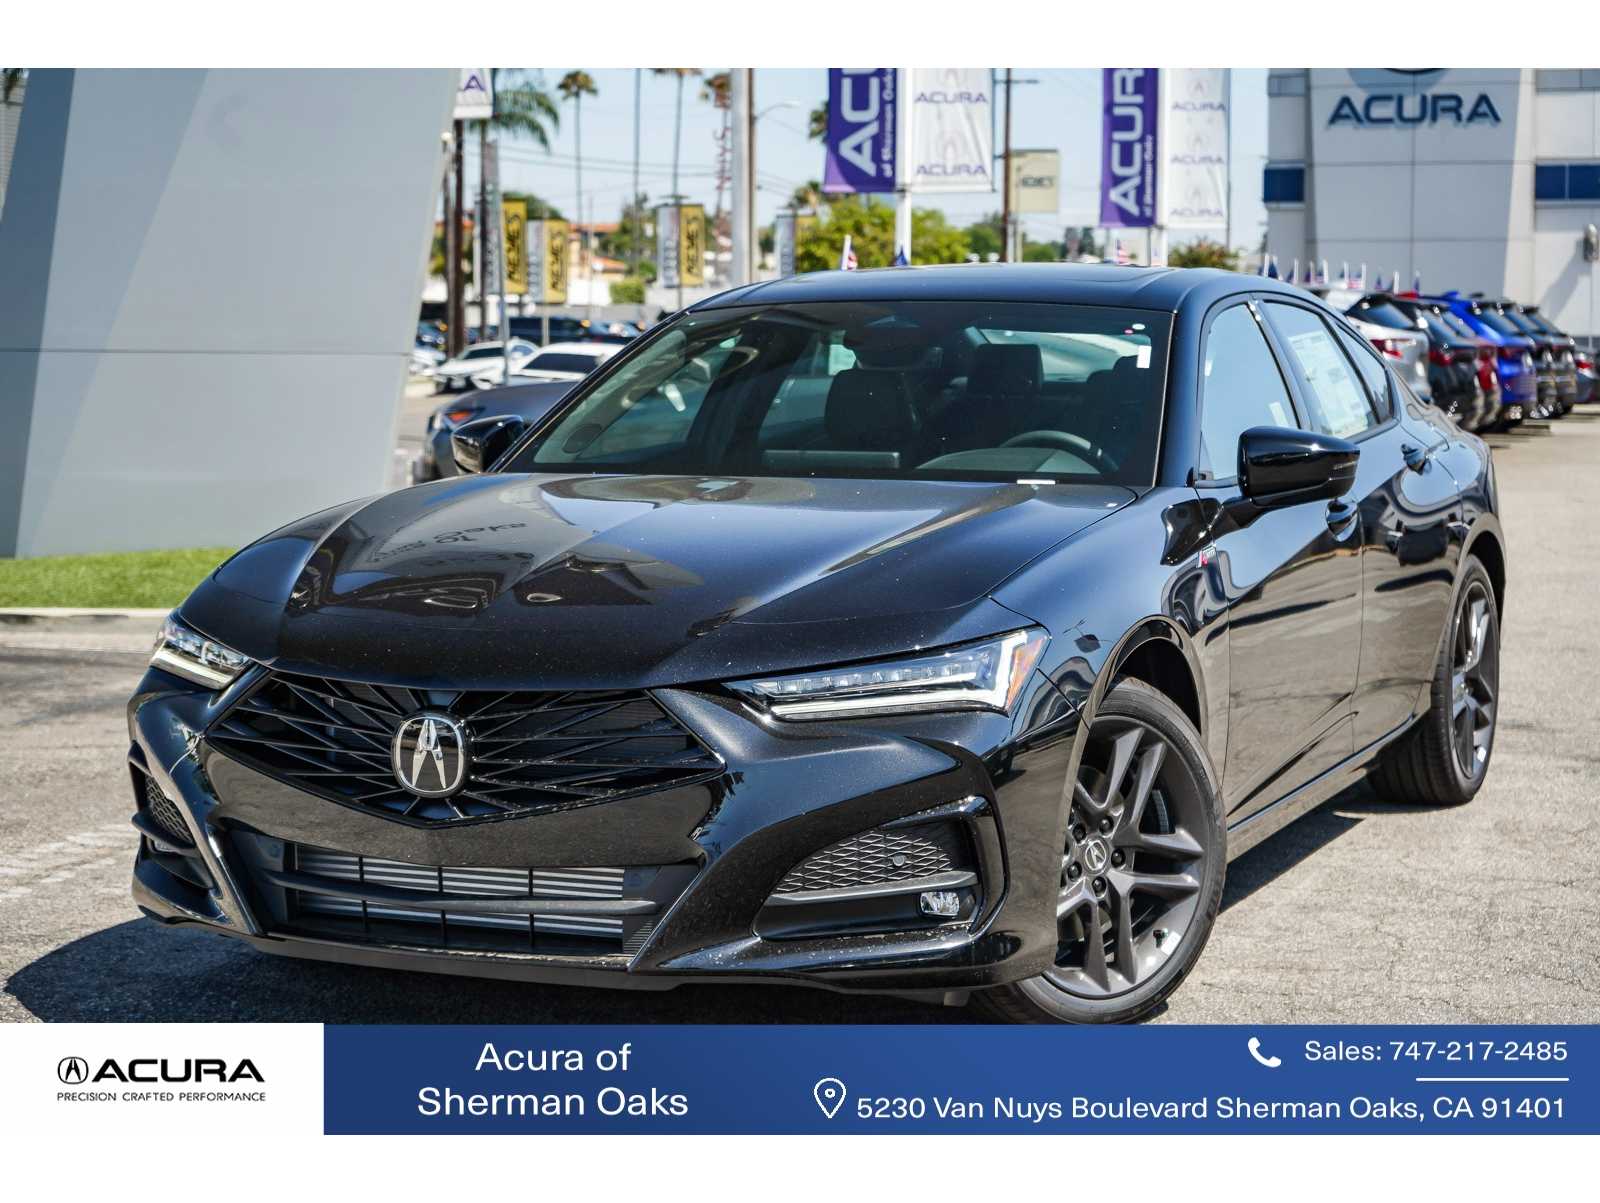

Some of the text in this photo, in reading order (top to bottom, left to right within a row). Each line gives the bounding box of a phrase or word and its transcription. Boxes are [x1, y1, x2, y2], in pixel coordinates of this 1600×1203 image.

[915, 91, 988, 104] ACURA
[1171, 101, 1227, 112] ACURA
[1328, 93, 1501, 126] ACURA
[838, 68, 880, 177] AC
[1170, 155, 1224, 165] ACURA
[916, 163, 986, 176] ACURA
[1170, 208, 1224, 217] ACURA
